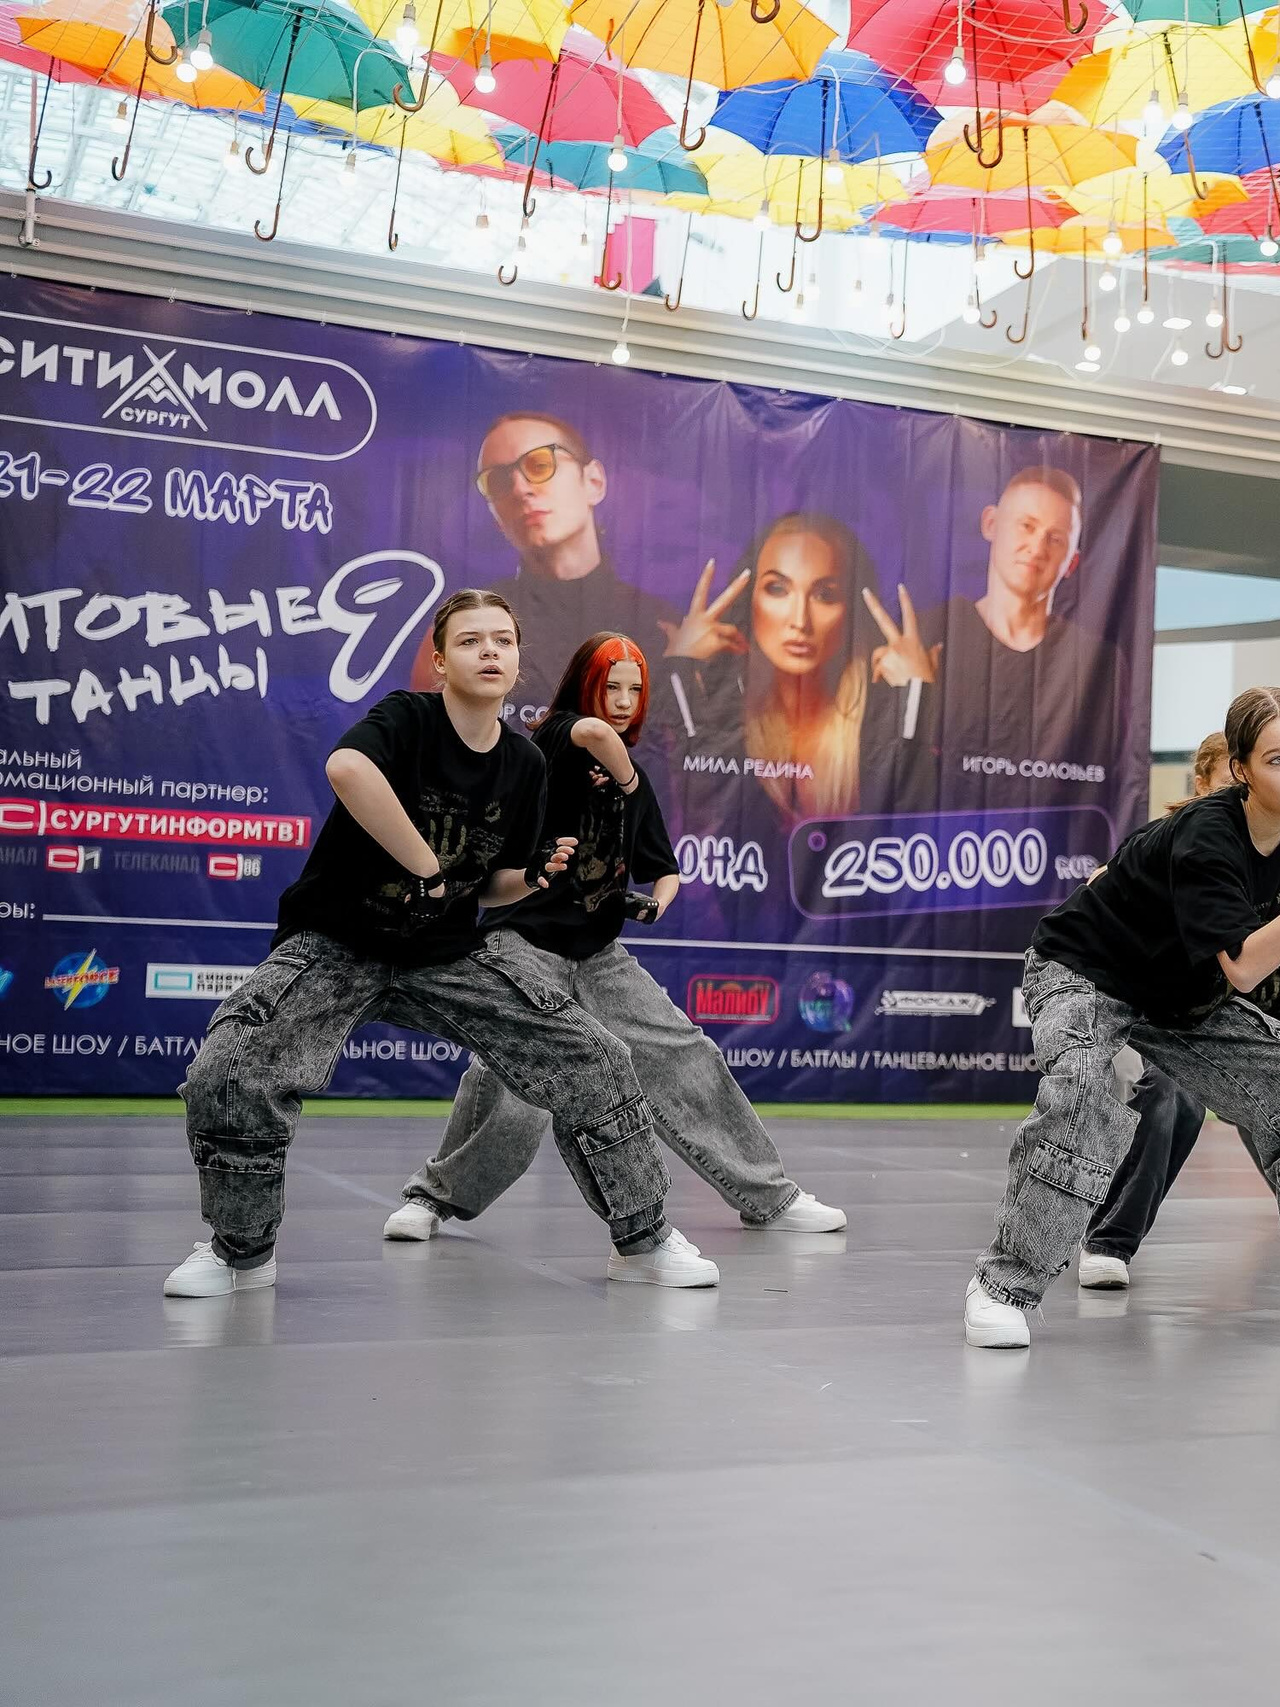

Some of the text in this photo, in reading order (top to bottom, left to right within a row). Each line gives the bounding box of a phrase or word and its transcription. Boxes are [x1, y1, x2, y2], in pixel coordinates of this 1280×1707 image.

[183, 362, 342, 421] МОЛЛ
[120, 407, 192, 429] СУРГУТ
[164, 467, 334, 535] МАРТА
[7, 643, 268, 726] ТАНЦЫ
[683, 755, 814, 780] МИЛА РЕДИНА
[962, 756, 1017, 776] ИГОРЬ
[161, 780, 269, 806] партнер:
[821, 827, 1048, 898] 250.000
[53, 1034, 112, 1055] ШОУ
[411, 1041, 463, 1061] ШОУ
[727, 1048, 775, 1067] ШОУ
[790, 1049, 857, 1069] БАТТЛЫ
[873, 1051, 1006, 1072] ТАНЦЕВАЛЬНОЕ
[1008, 1053, 1038, 1072] ШО
